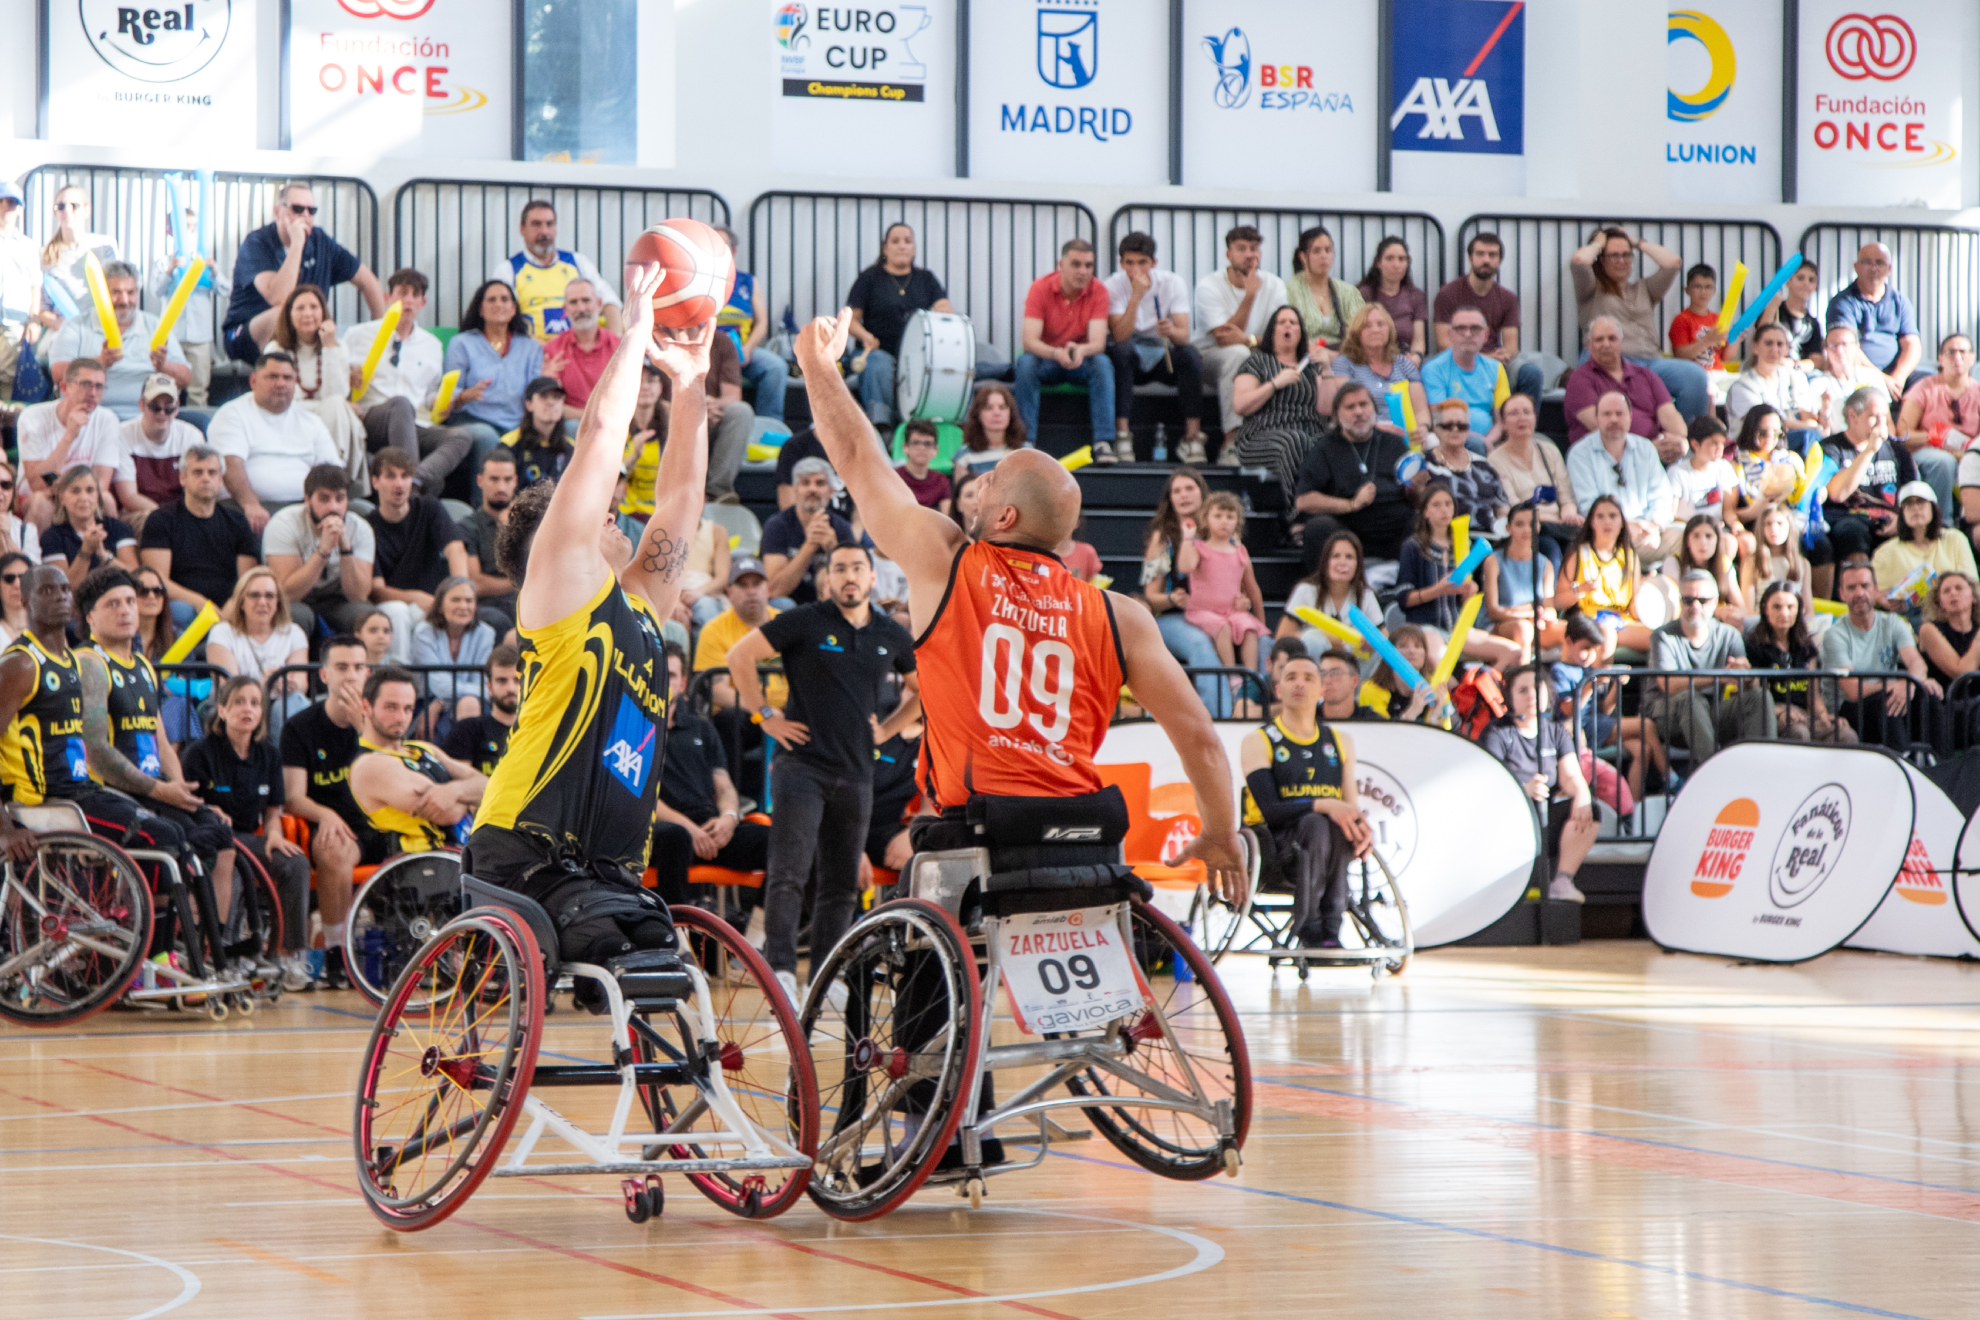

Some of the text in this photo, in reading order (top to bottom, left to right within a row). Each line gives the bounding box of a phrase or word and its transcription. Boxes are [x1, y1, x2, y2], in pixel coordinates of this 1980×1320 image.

[117, 4, 194, 45] Real
[818, 8, 896, 33] EURO
[321, 33, 449, 58] Fundación
[826, 46, 887, 69] CUP
[319, 63, 448, 98] ONCE
[1261, 64, 1314, 89] BSR
[115, 92, 172, 103] BURGER
[177, 95, 212, 106] KING
[807, 82, 906, 100] Champions Cup
[1261, 91, 1354, 113] ESPAÑA
[1815, 94, 1926, 116] Fundación
[1001, 104, 1132, 142] MADRID
[1391, 77, 1501, 141] AXA
[1814, 121, 1925, 151] ONCE
[614, 647, 666, 719] ILUNION
[979, 622, 1075, 743] 09
[604, 739, 643, 788] AXA
[1305, 767, 1316, 780] 7
[1280, 784, 1342, 800] ILUNION
[1356, 777, 1405, 817] ticos
[1792, 796, 1843, 841] Fanáticos
[1706, 828, 1755, 851] BURGER
[1695, 850, 1746, 881] KING
[1785, 843, 1828, 878] Real
[1032, 915, 1067, 925] amiab
[1760, 913, 1785, 926] BURGER
[1785, 915, 1803, 928] KING
[1010, 930, 1110, 956] ZARZUELA
[1038, 954, 1101, 995] 09
[1041, 999, 1132, 1029] gaviota
